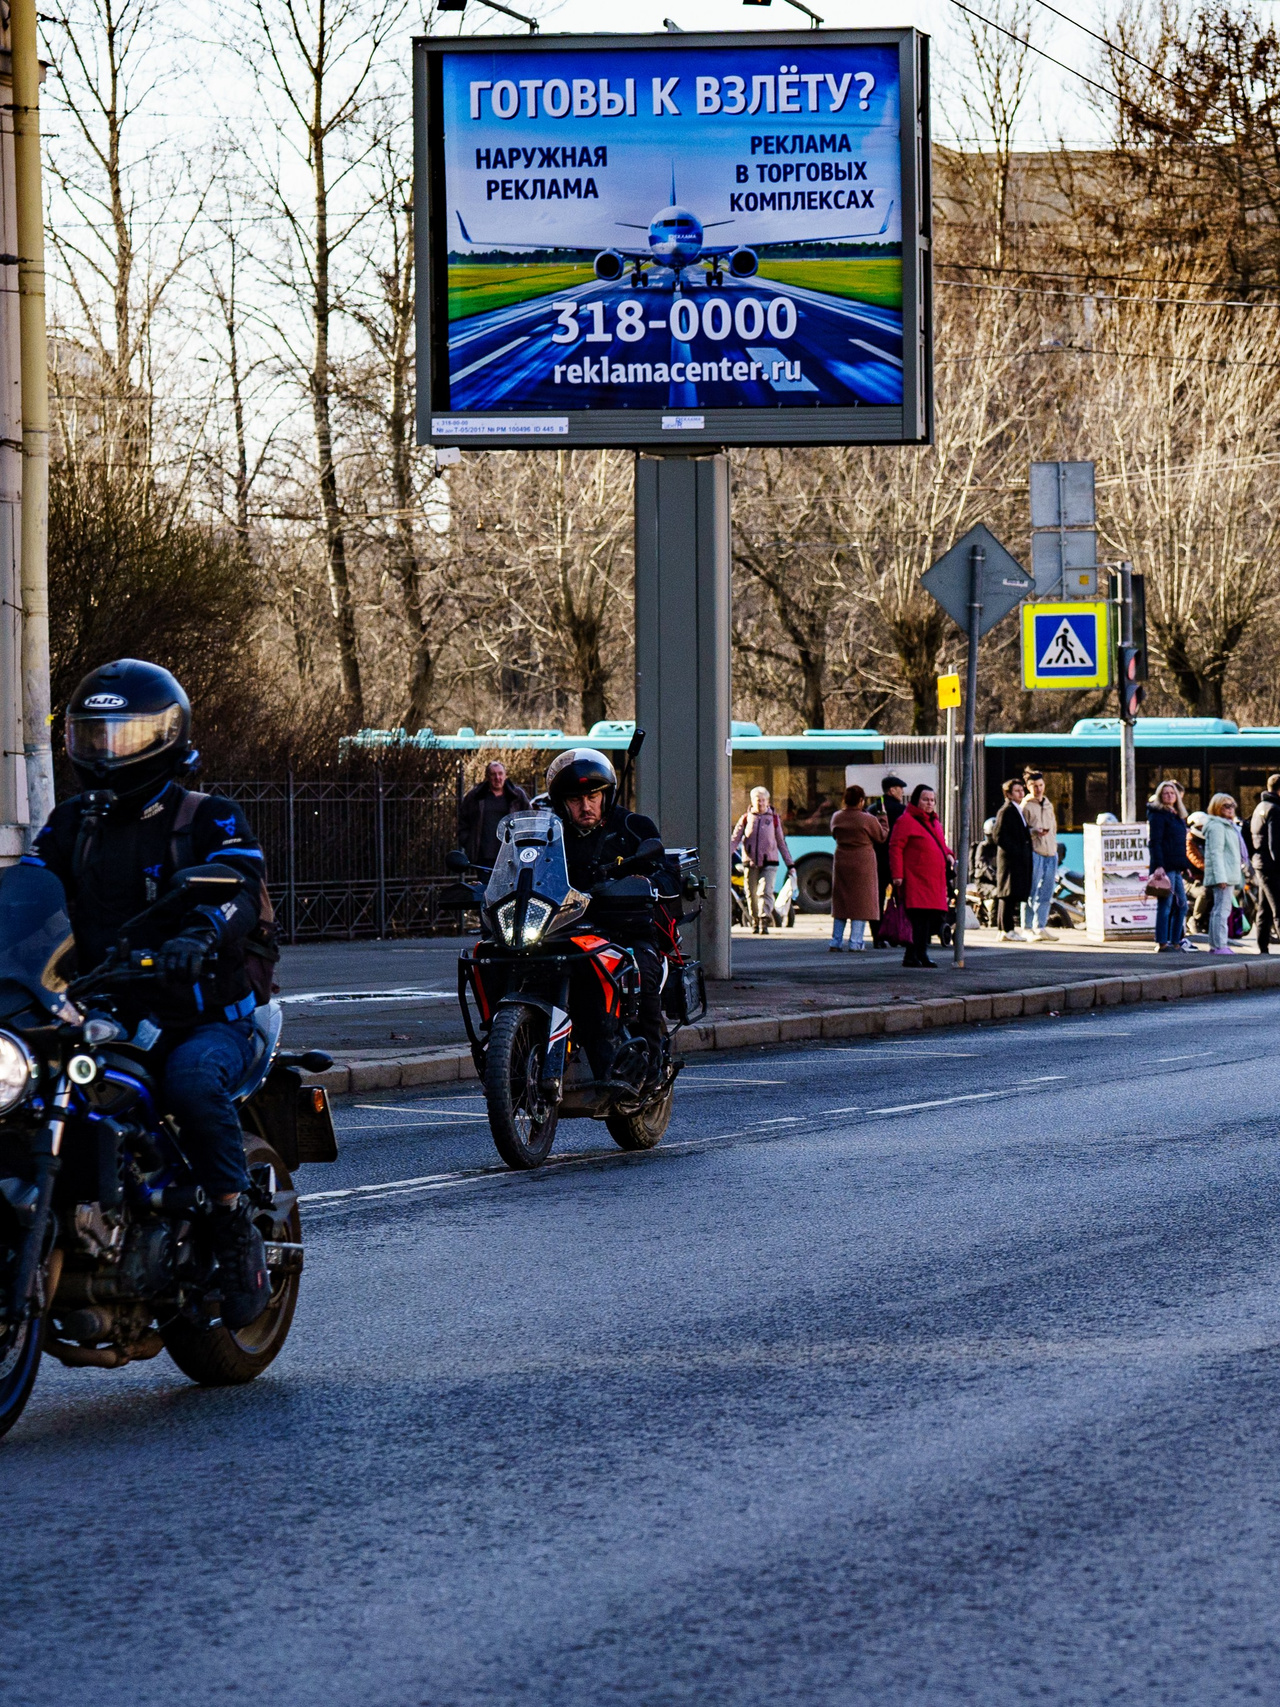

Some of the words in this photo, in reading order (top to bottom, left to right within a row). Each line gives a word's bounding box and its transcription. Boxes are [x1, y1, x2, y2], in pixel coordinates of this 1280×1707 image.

[469, 77, 637, 119] ГОТОВЫ
[652, 76, 681, 116] К
[695, 64, 876, 116] ВЗЛЁТУ?
[750, 133, 852, 155] РЕКЛАМА
[475, 145, 608, 170] НАРУЖНАЯ
[735, 164, 749, 184] В
[755, 161, 868, 184] ТОРГОВЫХ
[486, 177, 600, 201] РЕКЛАМА
[729, 189, 875, 213] КОМПЛЕКСАХ
[551, 296, 798, 344] 318-0000
[553, 355, 802, 384] reklamacenter.ru
[87, 697, 121, 706] HJC
[1103, 838, 1150, 849] НОРВЕЖСК
[1104, 850, 1144, 862] ЯРМАРКА
